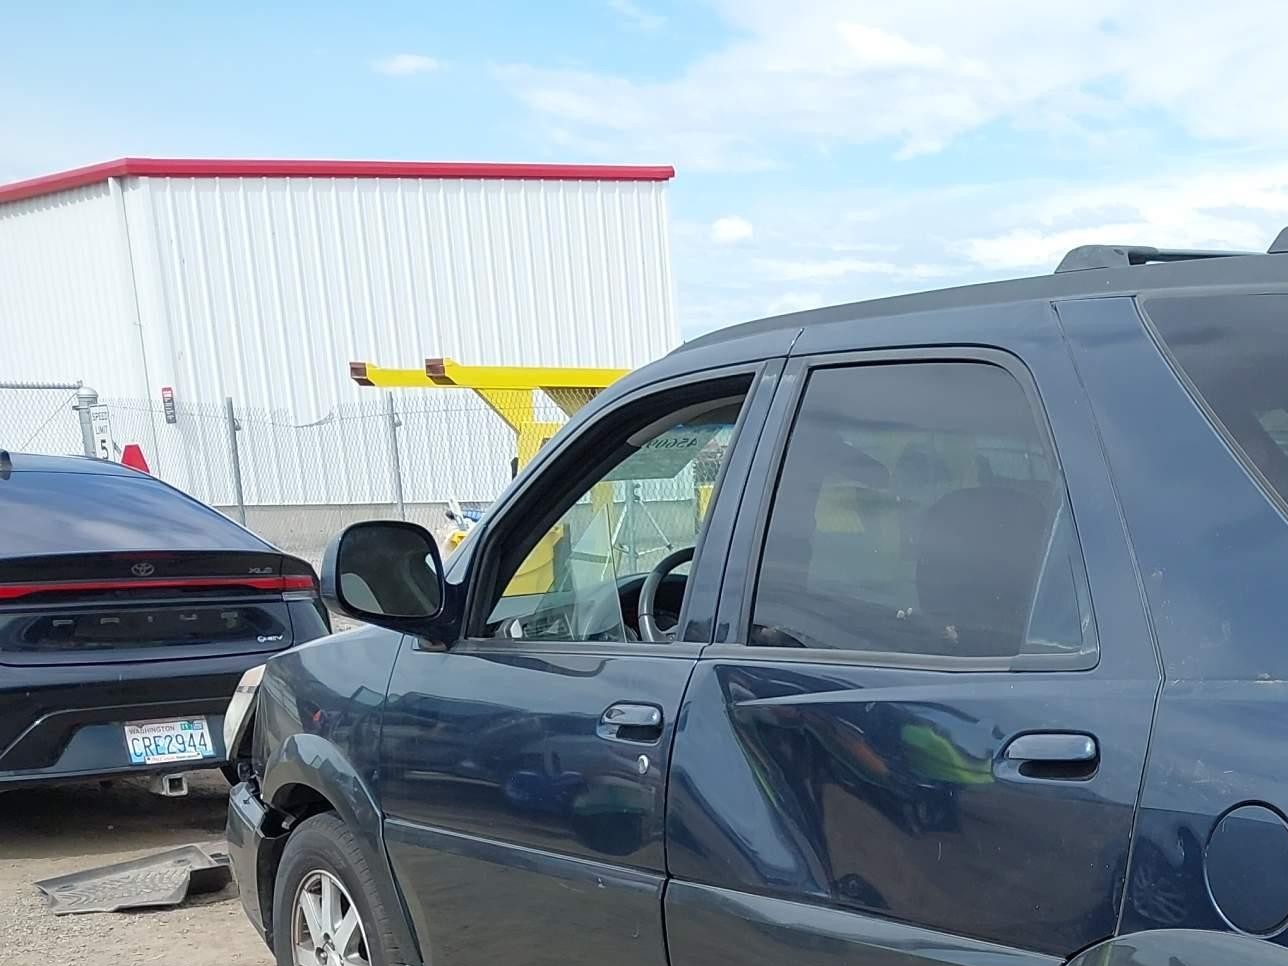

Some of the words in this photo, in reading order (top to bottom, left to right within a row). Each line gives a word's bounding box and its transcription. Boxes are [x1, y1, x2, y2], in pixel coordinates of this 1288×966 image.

[100, 439, 109, 460] 5
[128, 725, 175, 735] WASHINGTON
[131, 732, 208, 757] CRE2944
